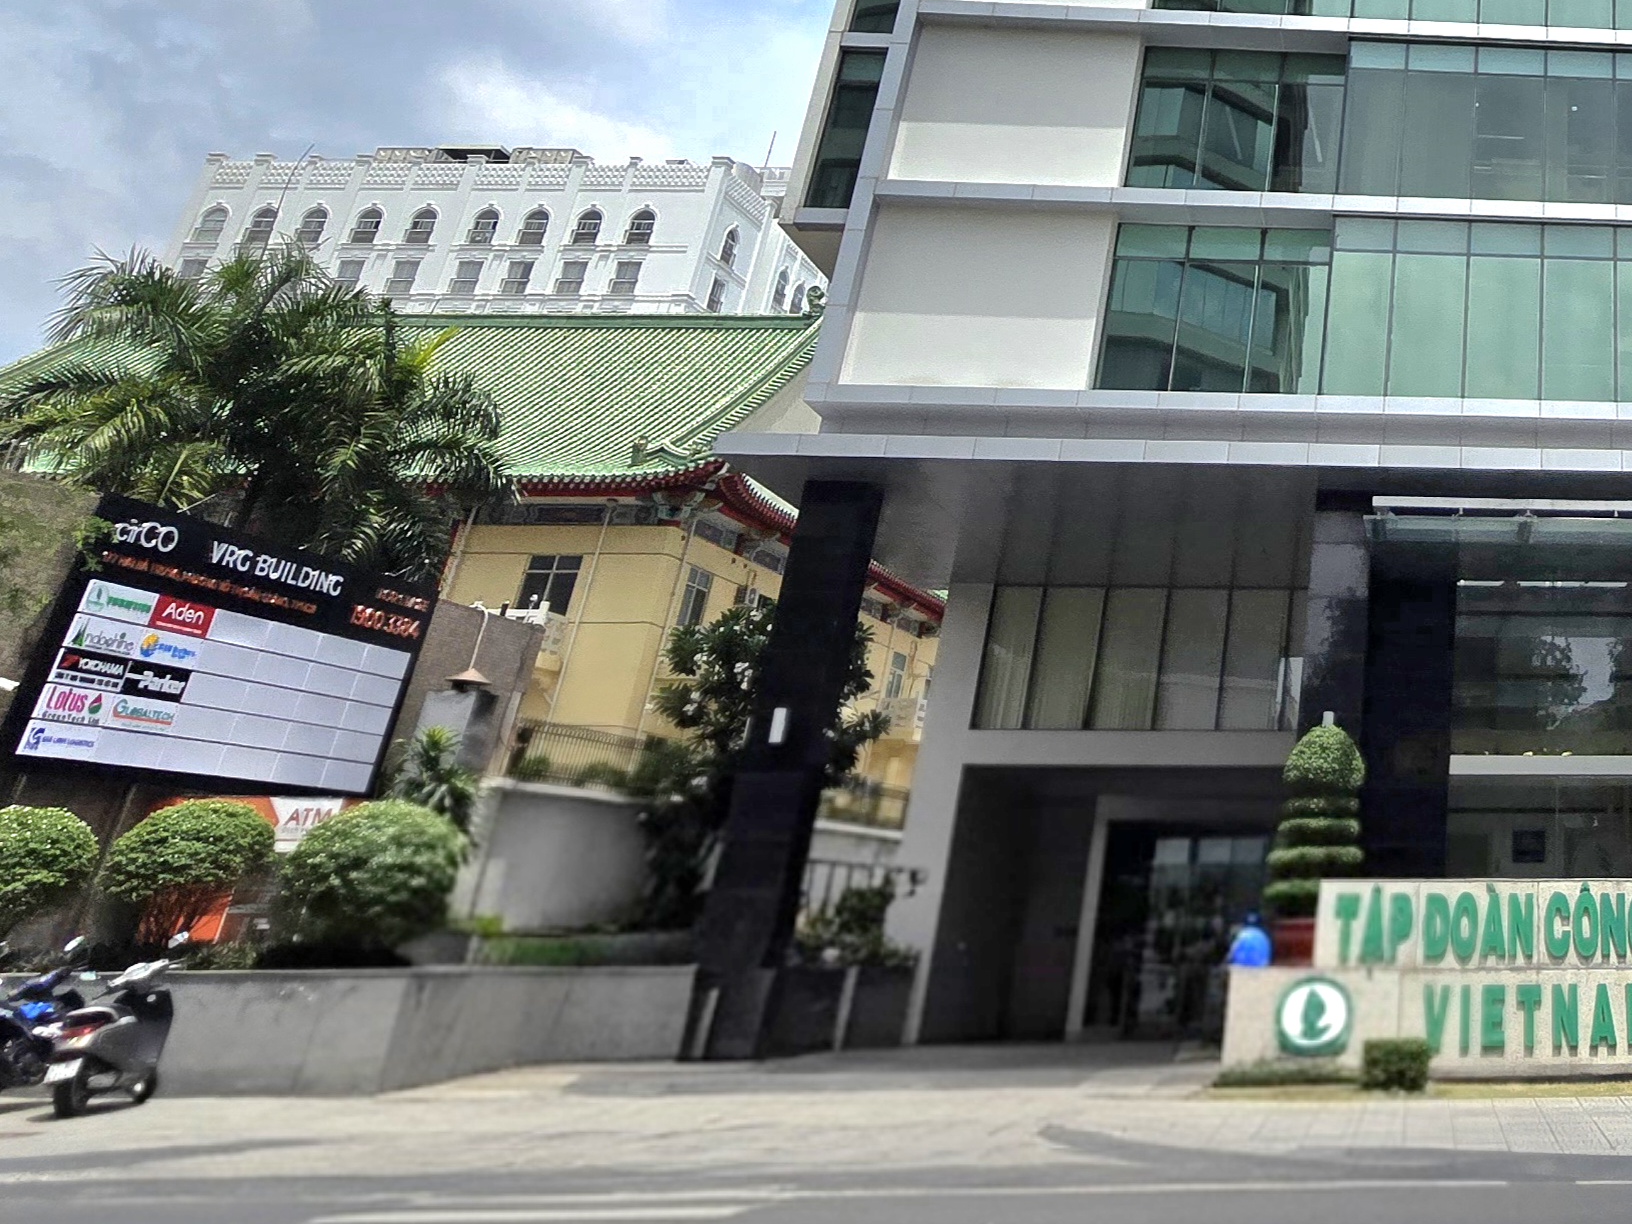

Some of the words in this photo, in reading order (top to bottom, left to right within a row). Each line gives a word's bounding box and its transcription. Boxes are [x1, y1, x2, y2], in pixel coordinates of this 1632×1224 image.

[212, 541, 254, 572] VRG
[254, 554, 344, 596] BUILDING
[161, 603, 205, 625] Aden
[78, 657, 124, 675] YOKOHAMA
[46, 686, 88, 713] Lotus
[283, 807, 334, 826] ATM
